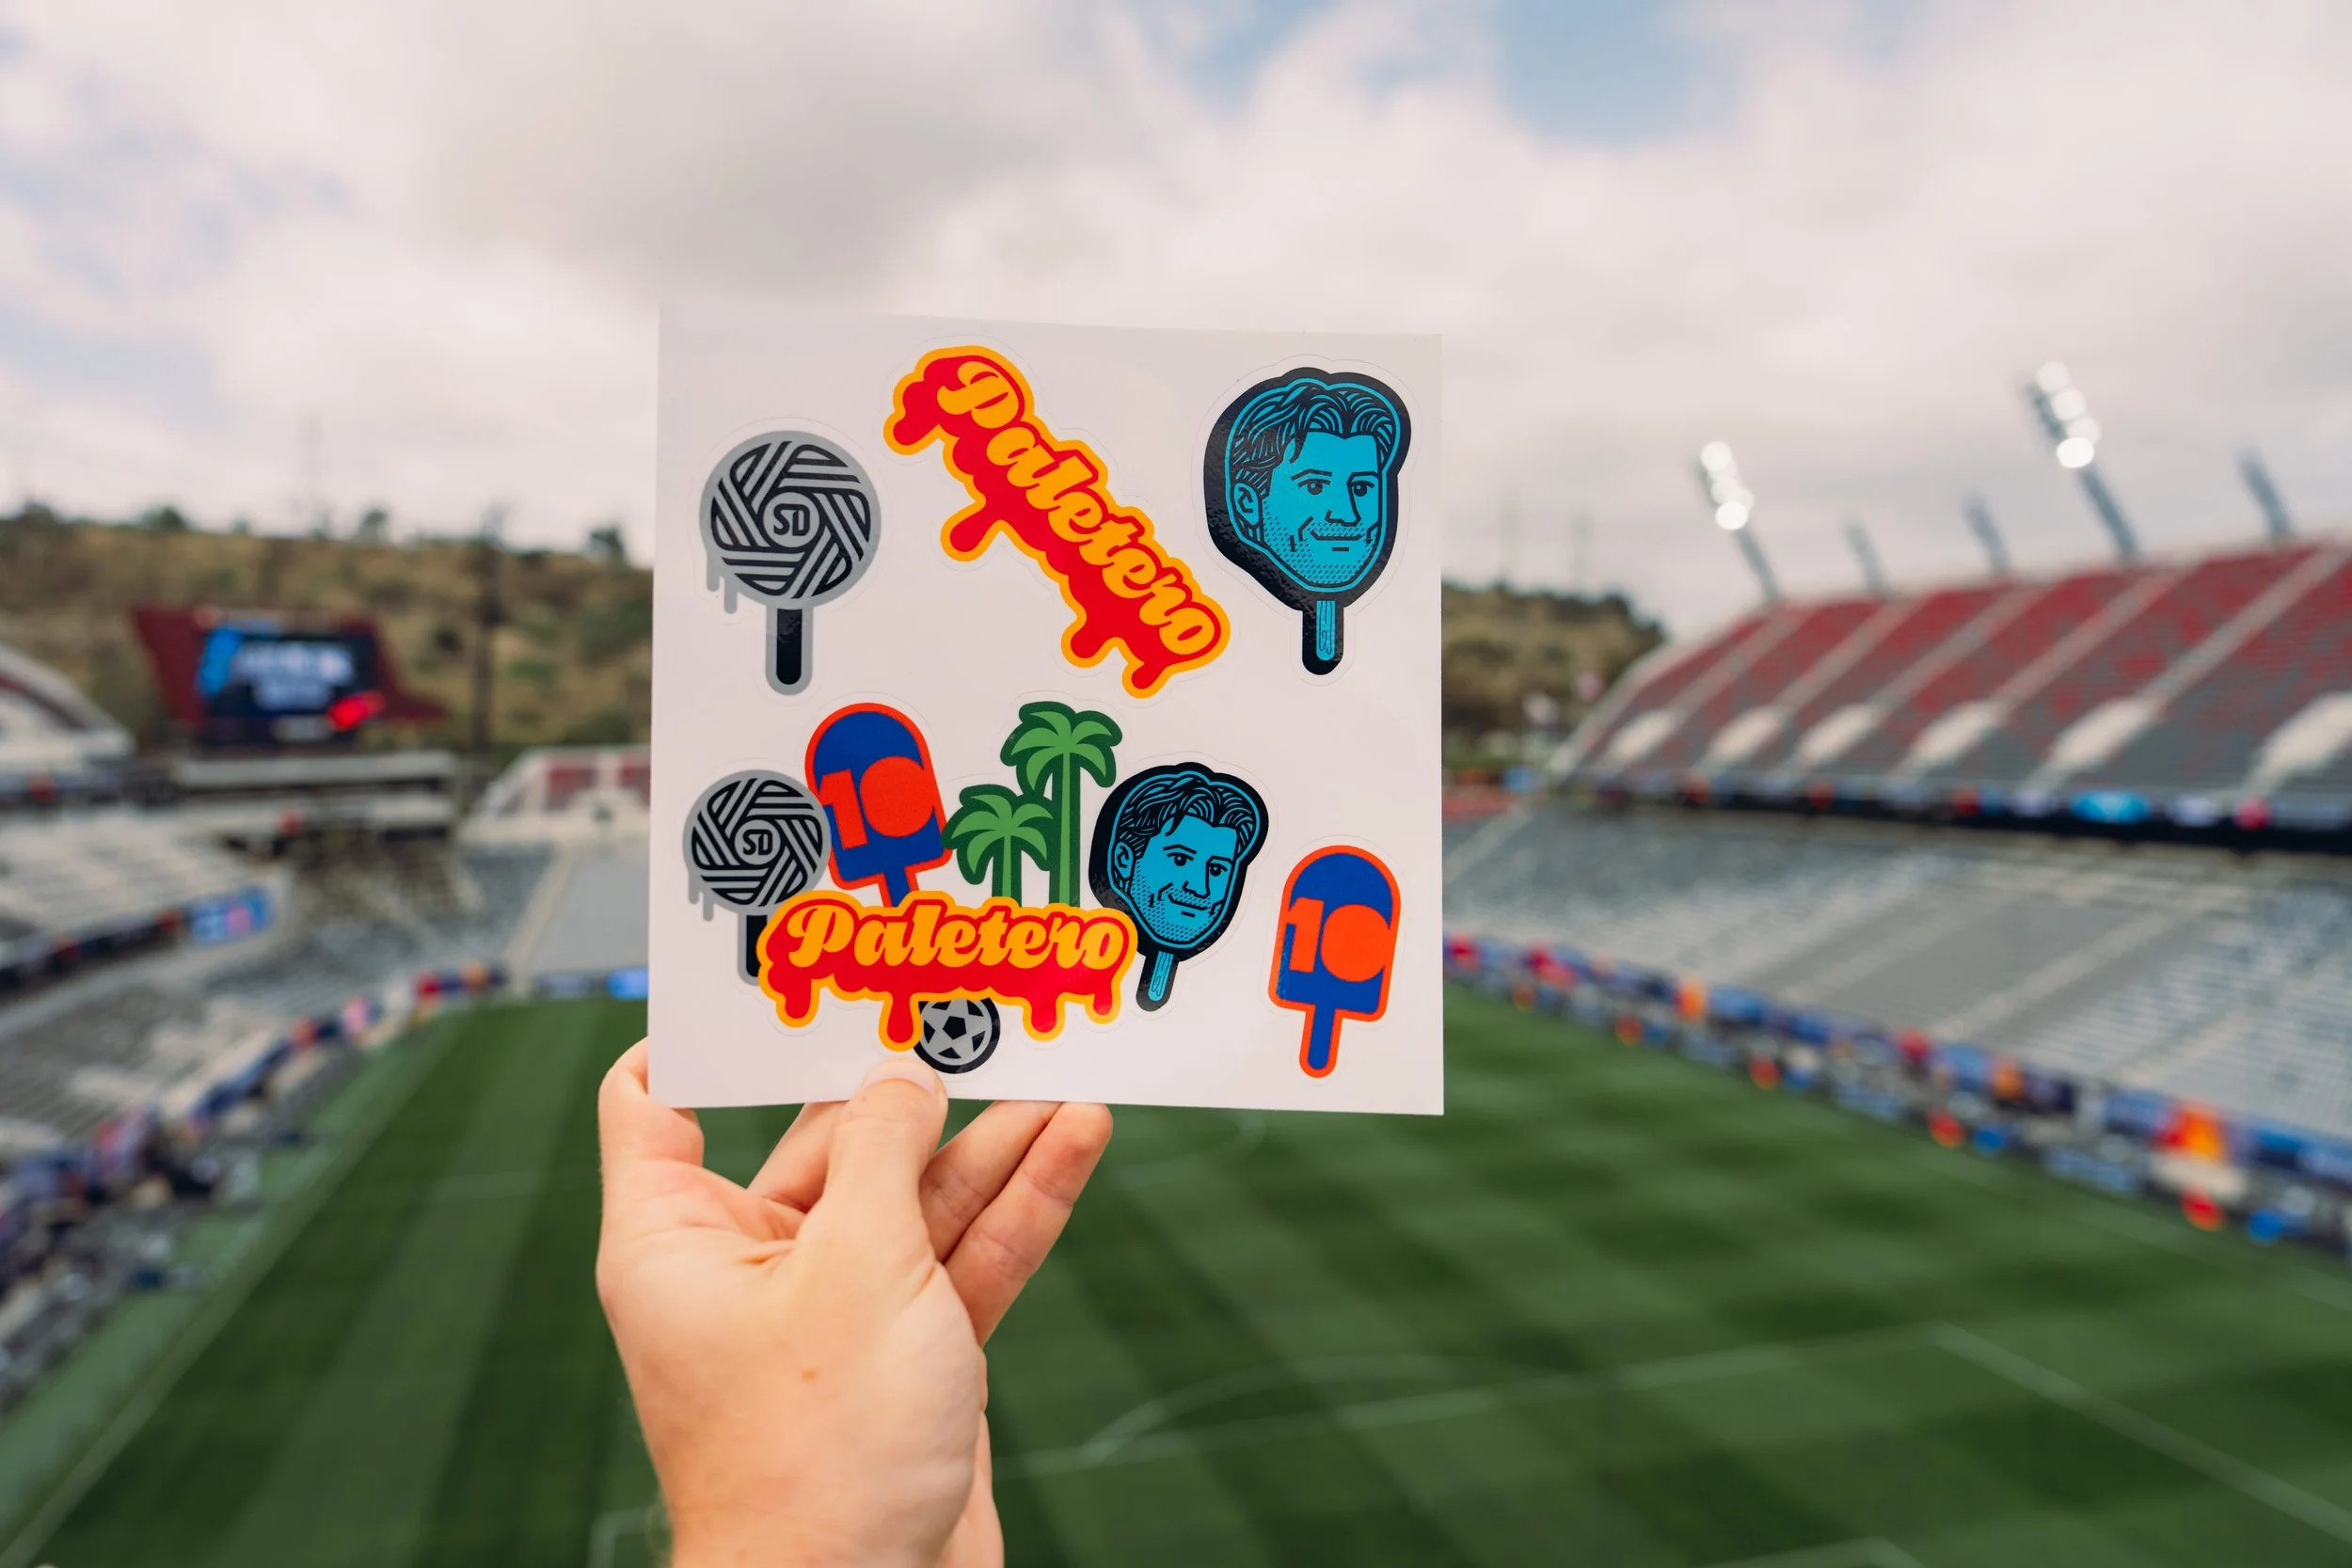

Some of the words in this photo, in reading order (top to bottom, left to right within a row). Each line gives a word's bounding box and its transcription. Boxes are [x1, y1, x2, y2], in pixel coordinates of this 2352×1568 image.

[773, 503, 810, 536] SD
[936, 360, 1216, 656] Paletero
[818, 755, 937, 850] 10
[742, 829, 773, 855] SD
[786, 904, 1125, 970] Paletero
[1284, 896, 1392, 983] 10
